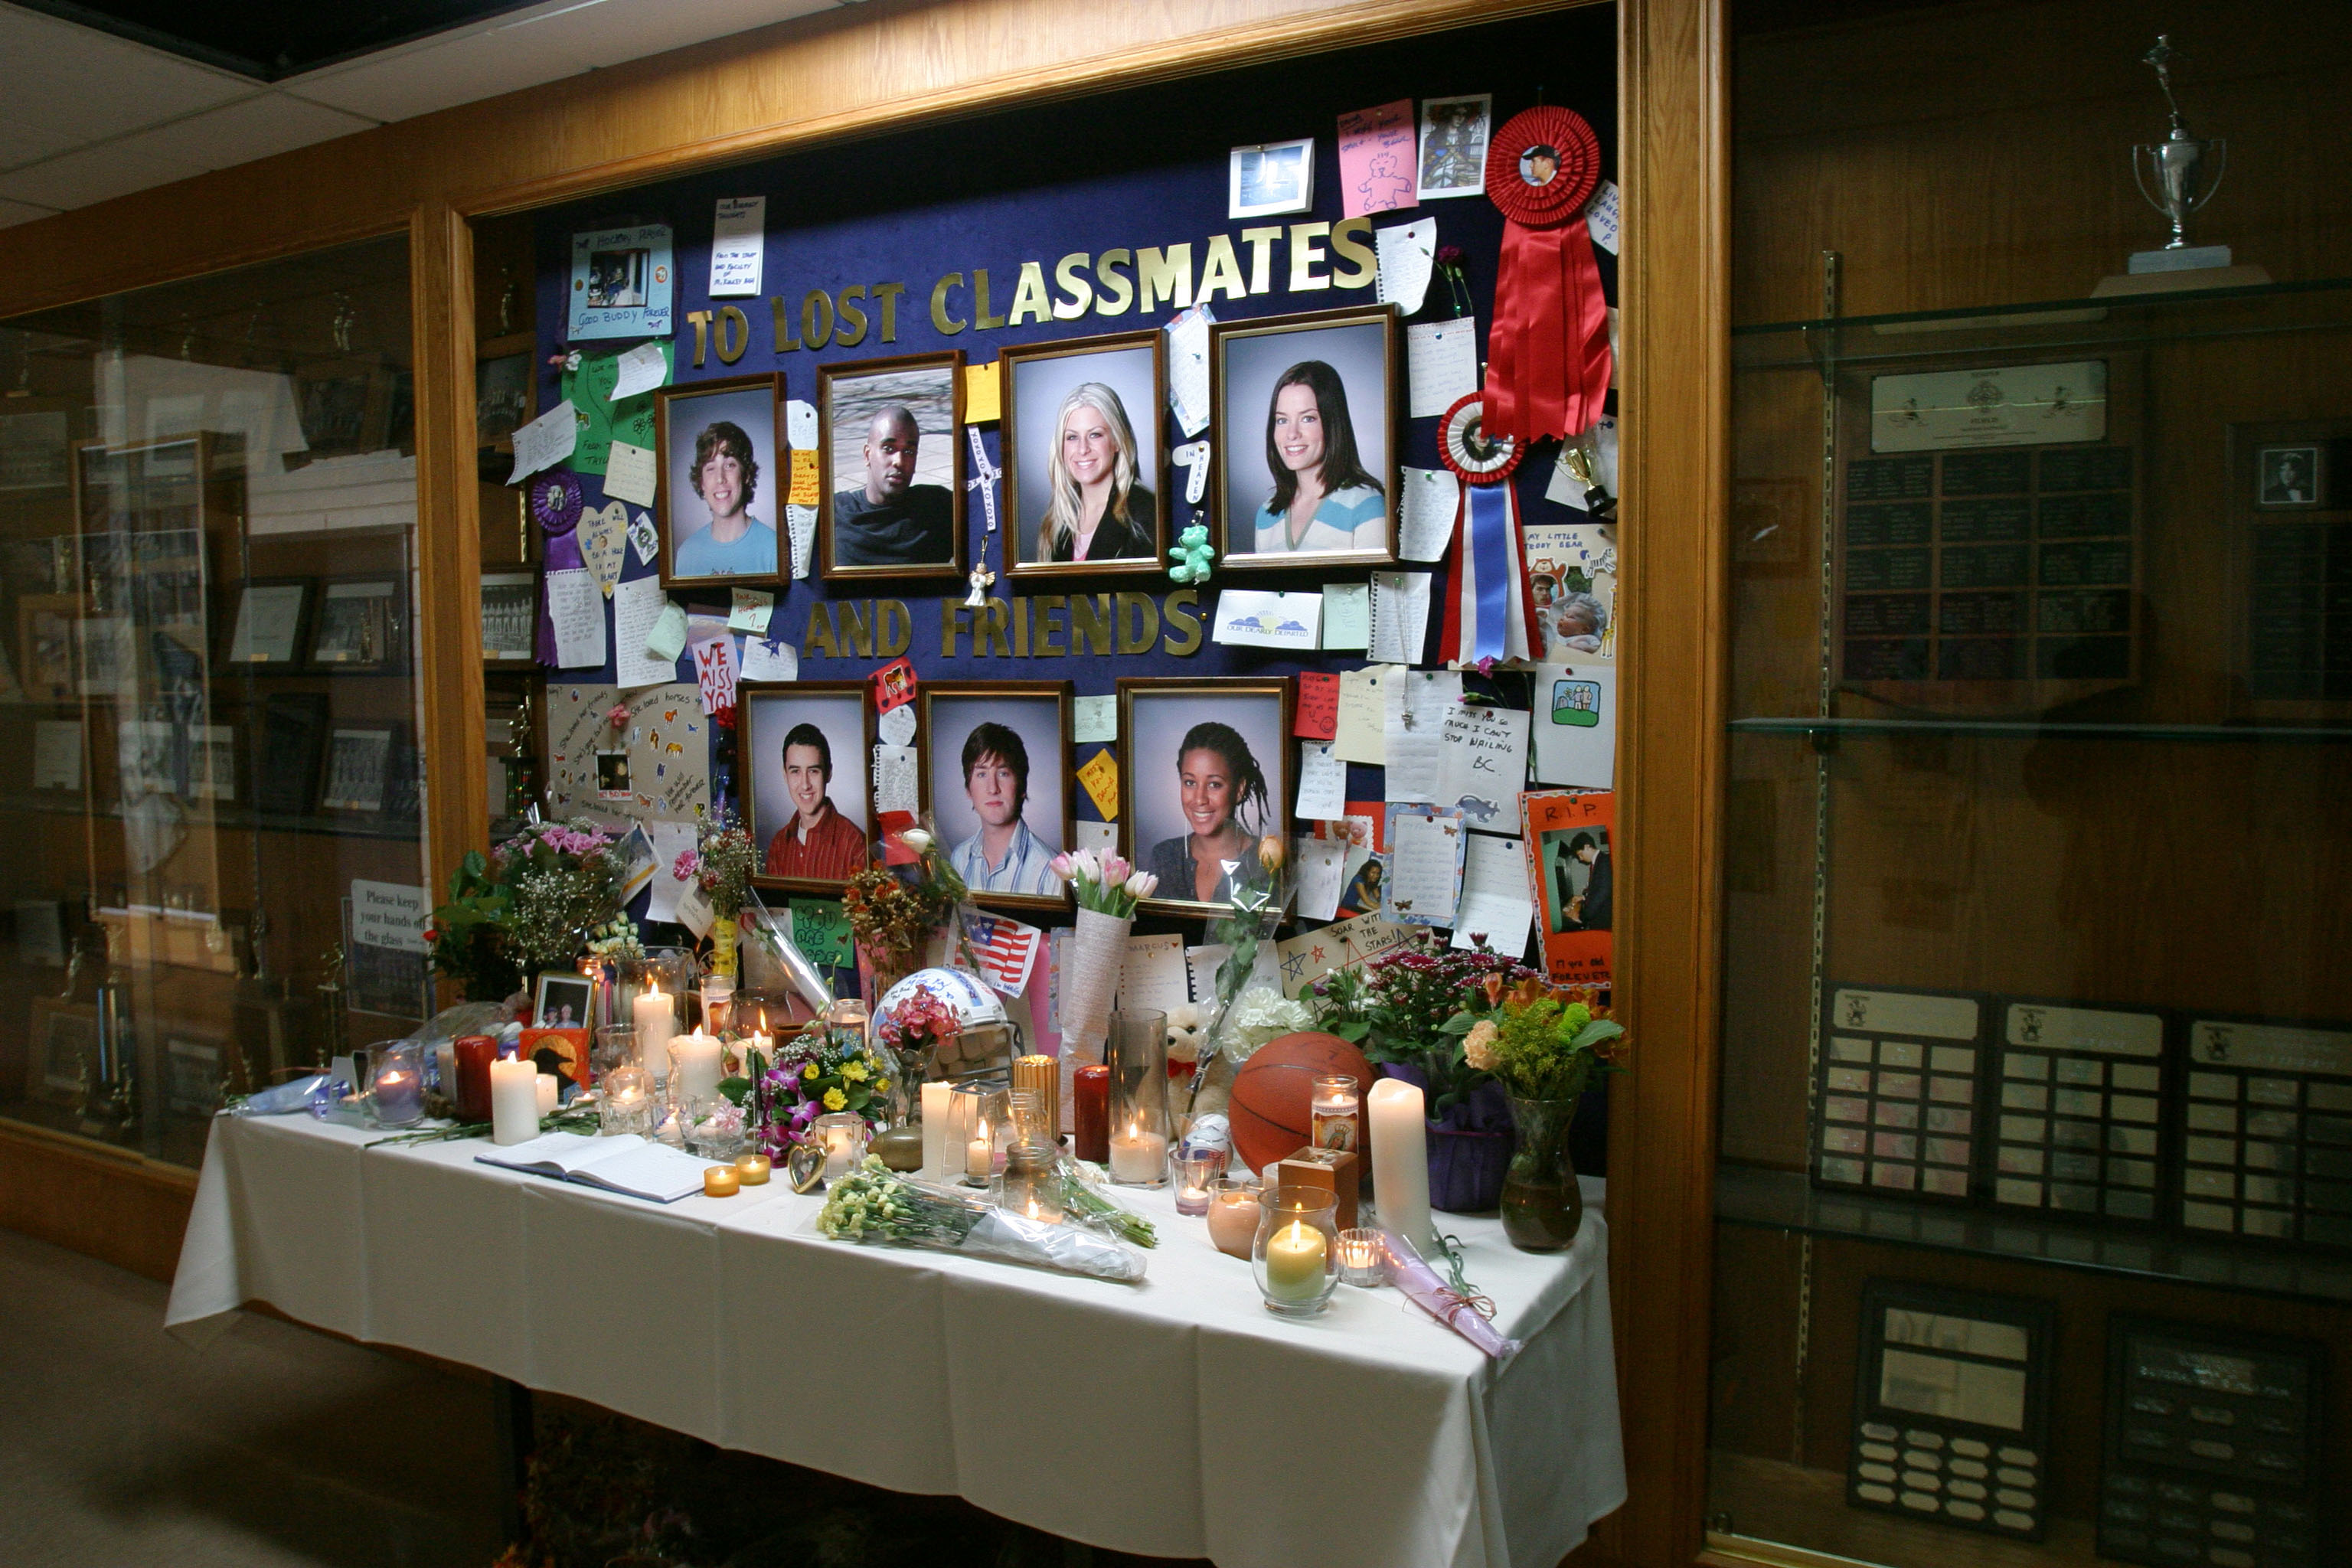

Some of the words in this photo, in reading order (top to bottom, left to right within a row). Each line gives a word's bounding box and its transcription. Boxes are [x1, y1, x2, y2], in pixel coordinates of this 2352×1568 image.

[687, 305, 749, 368] TO
[770, 283, 906, 354] LOST
[930, 217, 1380, 336] CLASSMATES
[603, 310, 638, 325] BUDDY
[642, 306, 670, 319] FOREVER
[1186, 449, 1195, 458] IN
[1547, 532, 1579, 541] LITTLE
[1559, 541, 1583, 549] BEAR
[802, 598, 913, 658] AND
[941, 589, 1204, 658] FRIENDS
[1245, 626, 1273, 635] DEARLY
[697, 641, 727, 668] WE
[699, 665, 733, 691] MISS
[665, 691, 691, 704] horses
[1446, 707, 1455, 716] I
[1458, 709, 1478, 718] MISS
[1445, 718, 1469, 730] MUCH
[1472, 724, 1481, 733] I
[1444, 732, 1464, 743] STOP
[1469, 736, 1514, 753] WAILING
[367, 890, 394, 906] Please
[397, 893, 419, 912] keep
[360, 911, 381, 925] your
[384, 912, 412, 928] hands
[364, 929, 379, 942] the
[381, 932, 403, 946] glass
[795, 929, 825, 946] ARE
[1330, 923, 1354, 938] SOAR
[1359, 926, 1379, 939] THE
[1128, 941, 1170, 952] MARCUS
[1365, 929, 1397, 952] STARS!
